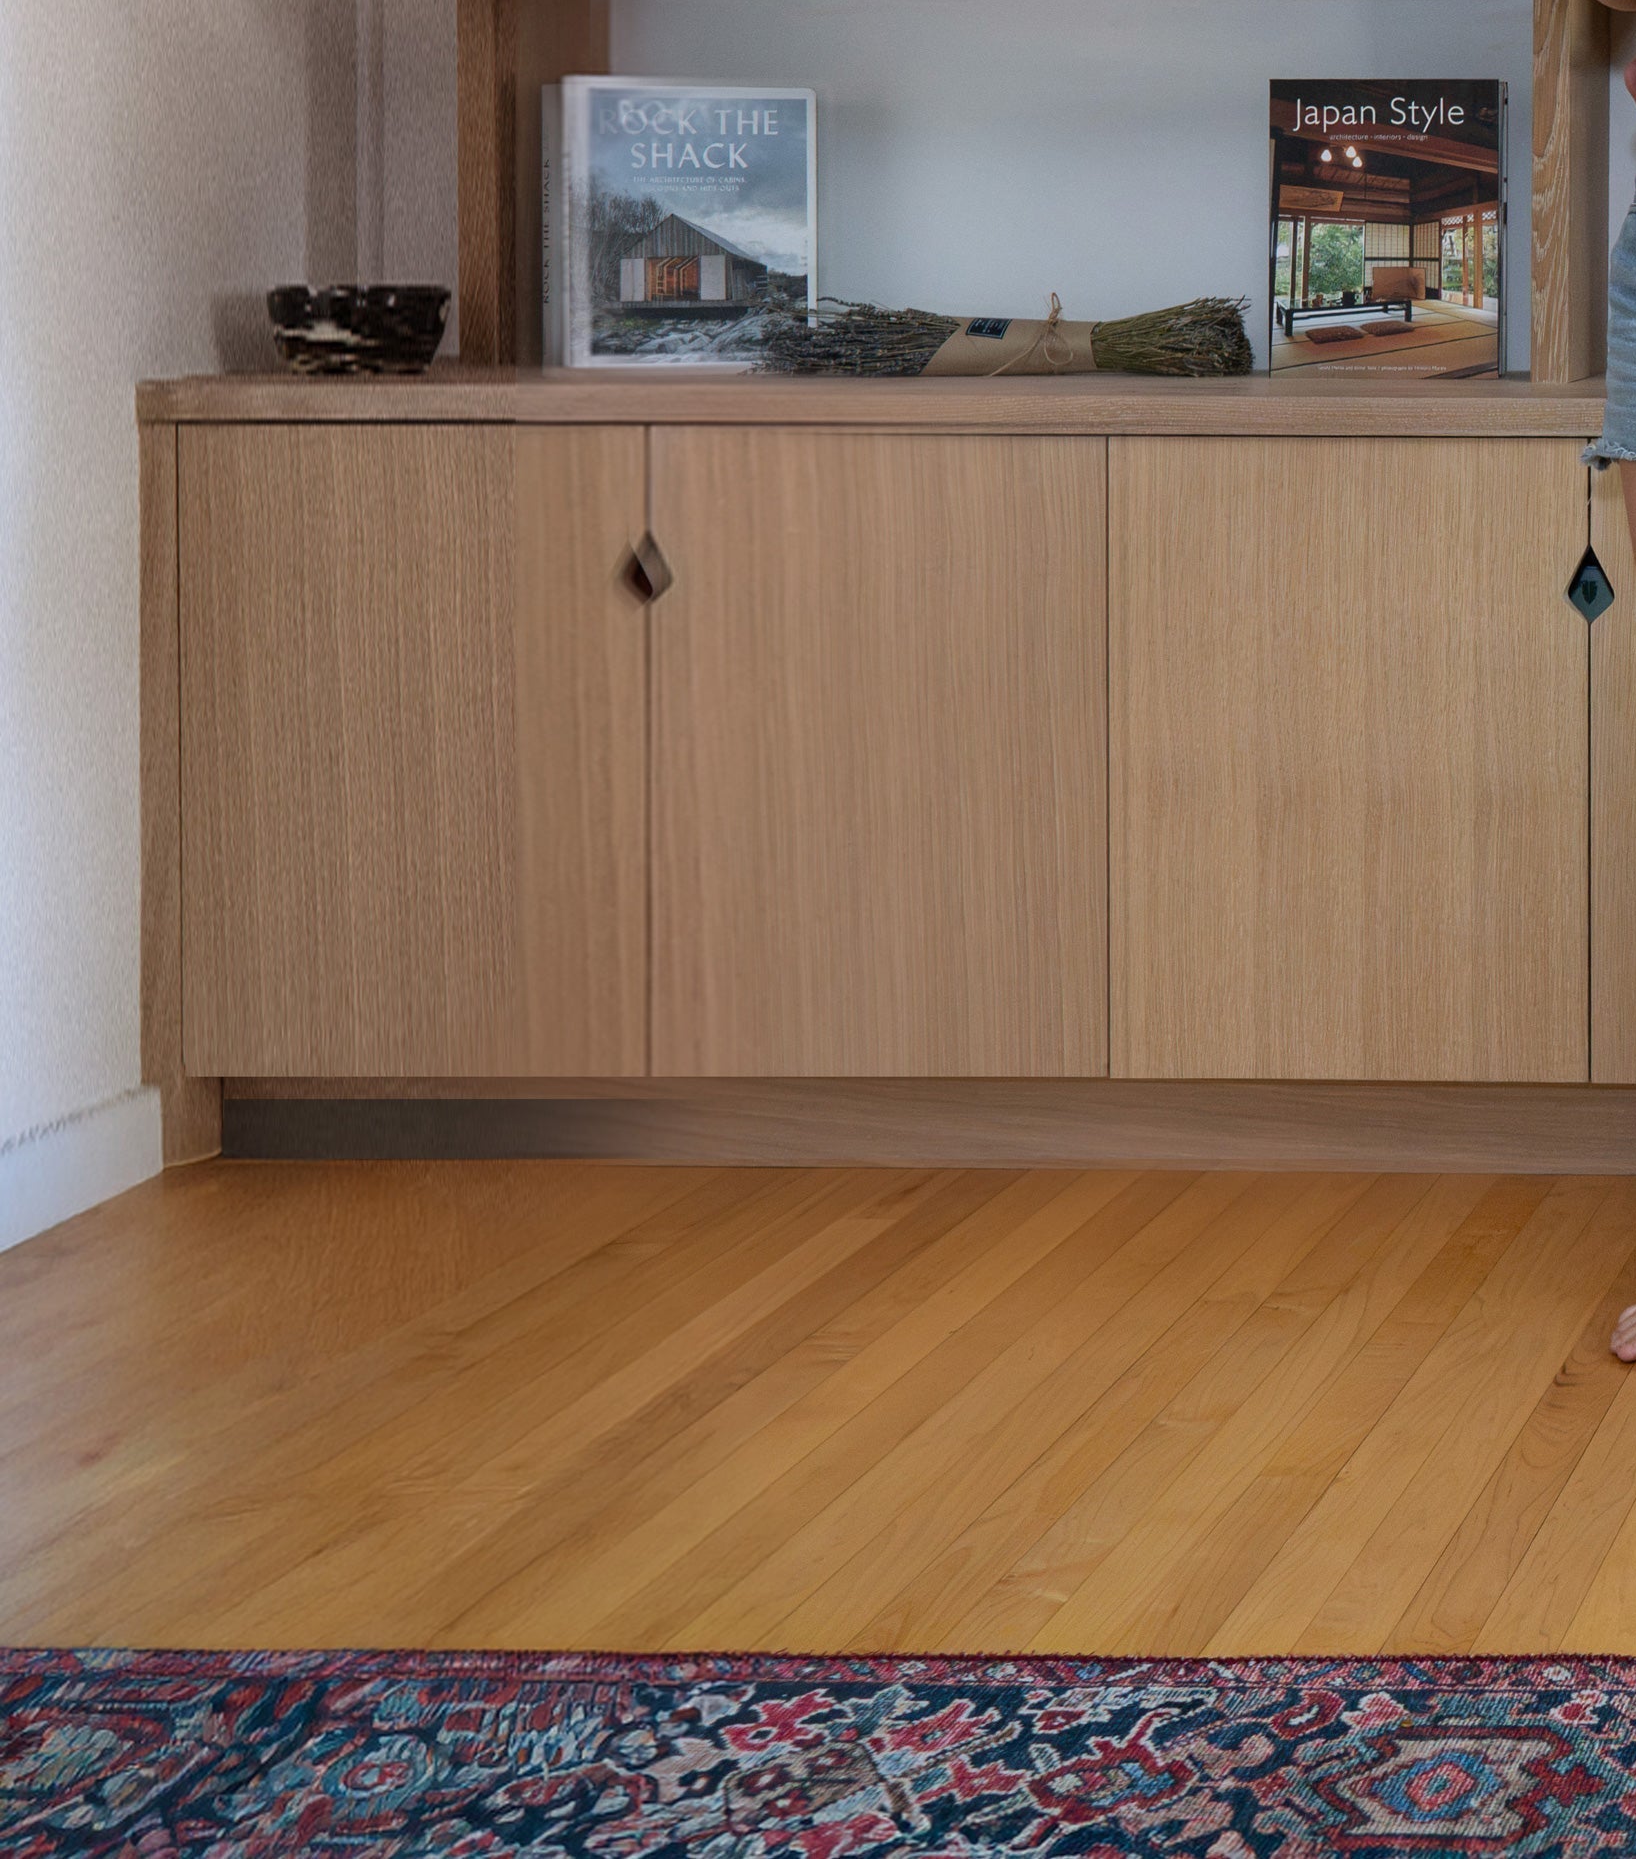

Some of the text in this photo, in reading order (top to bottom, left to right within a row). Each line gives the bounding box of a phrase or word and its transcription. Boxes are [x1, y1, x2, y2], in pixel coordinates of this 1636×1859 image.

[715, 109, 778, 134] THE
[1293, 97, 1464, 132] Japan Style
[631, 143, 748, 169] SHACK
